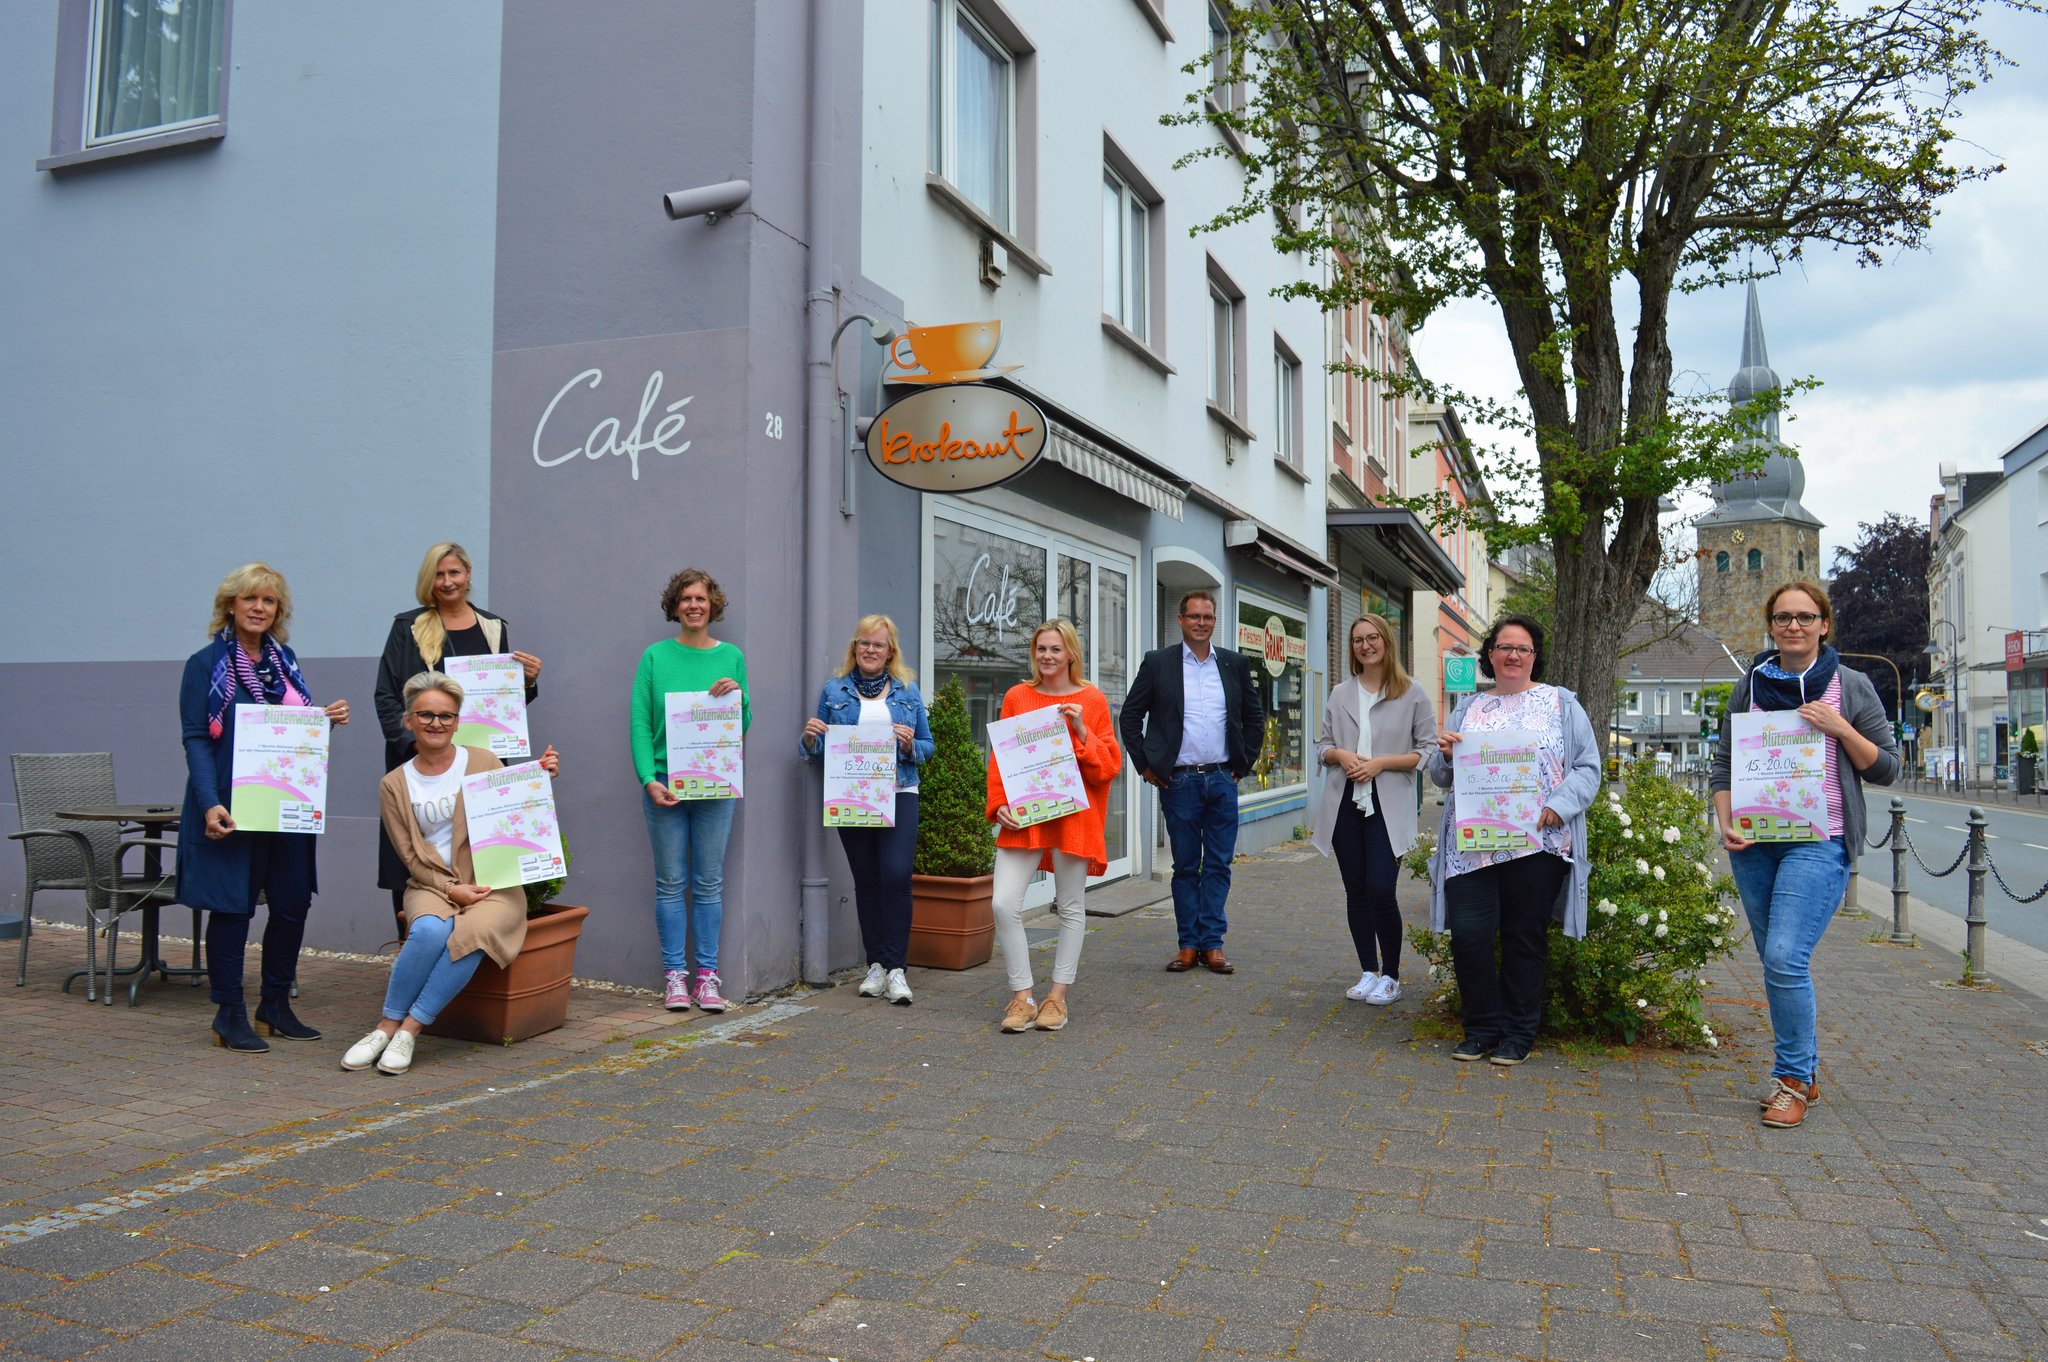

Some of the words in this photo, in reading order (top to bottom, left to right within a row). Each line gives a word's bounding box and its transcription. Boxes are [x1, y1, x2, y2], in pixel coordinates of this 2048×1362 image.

[532, 368, 694, 481] Café
[765, 411, 783, 440] 28
[966, 552, 1020, 643] Café
[264, 708, 325, 727] Blütenwoche
[690, 706, 740, 722] Blütenwoche
[1016, 721, 1066, 746] Blütenwoche
[1762, 726, 1822, 748] Blütenwoche
[848, 740, 895, 755] Blütenwoche
[1480, 747, 1536, 765] Blütenwoche
[487, 764, 544, 789] Blütenwoche
